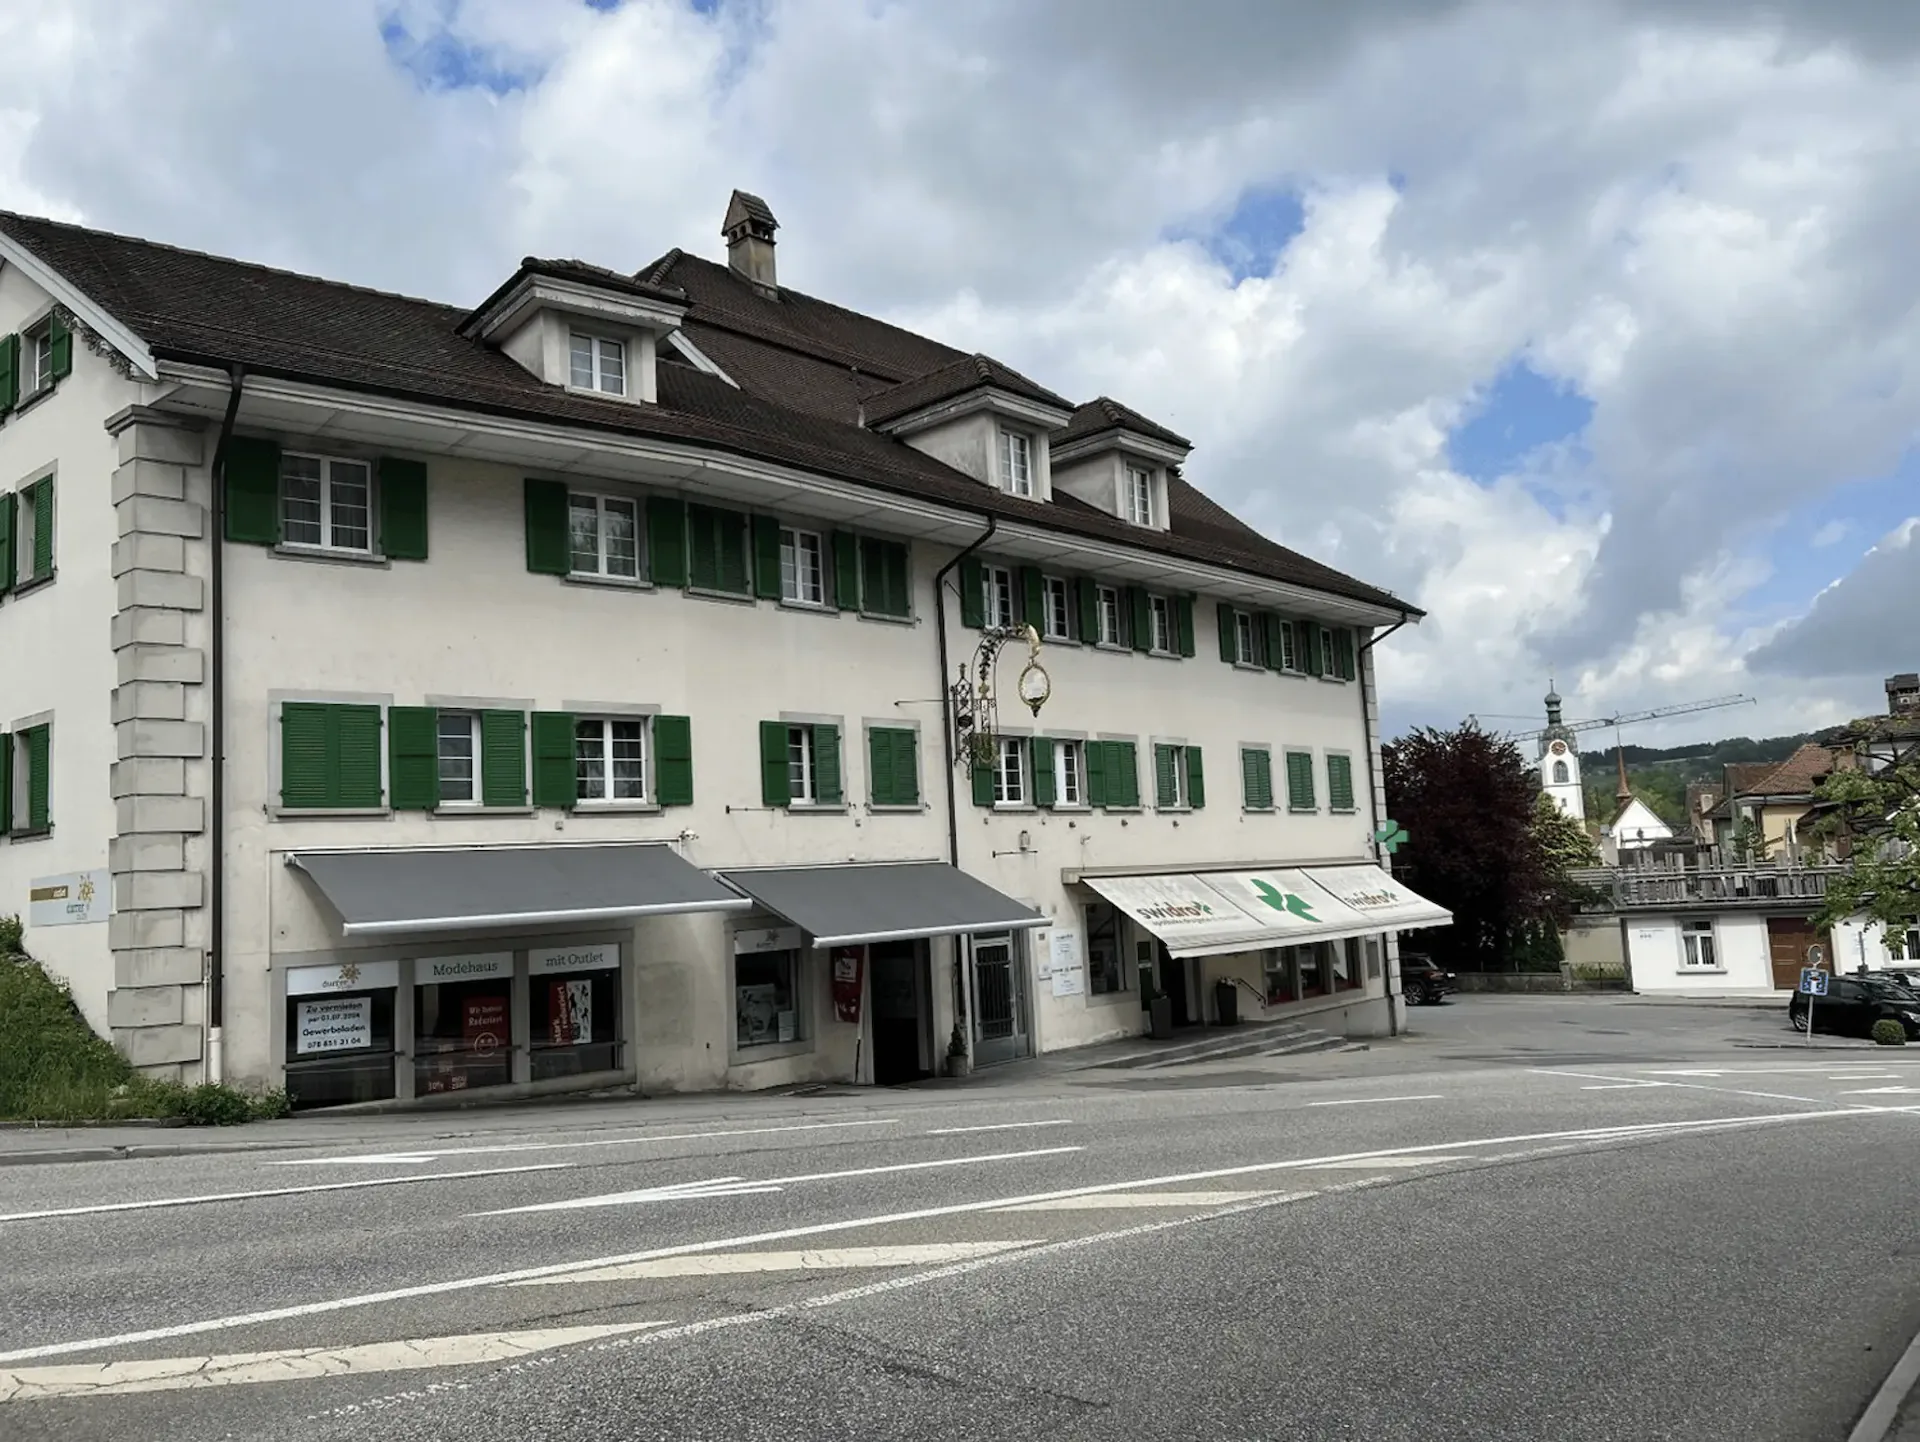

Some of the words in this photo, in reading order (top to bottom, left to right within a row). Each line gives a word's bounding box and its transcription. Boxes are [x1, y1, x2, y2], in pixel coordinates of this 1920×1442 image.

[1136, 901, 1201, 919] swidro
[545, 954, 566, 967] mit
[568, 951, 604, 965] Outlet
[433, 960, 499, 976] Modehaus
[306, 1004, 318, 1014] Zu
[319, 1002, 363, 1013] vermieten
[302, 1023, 366, 1036] Gewerbeladen
